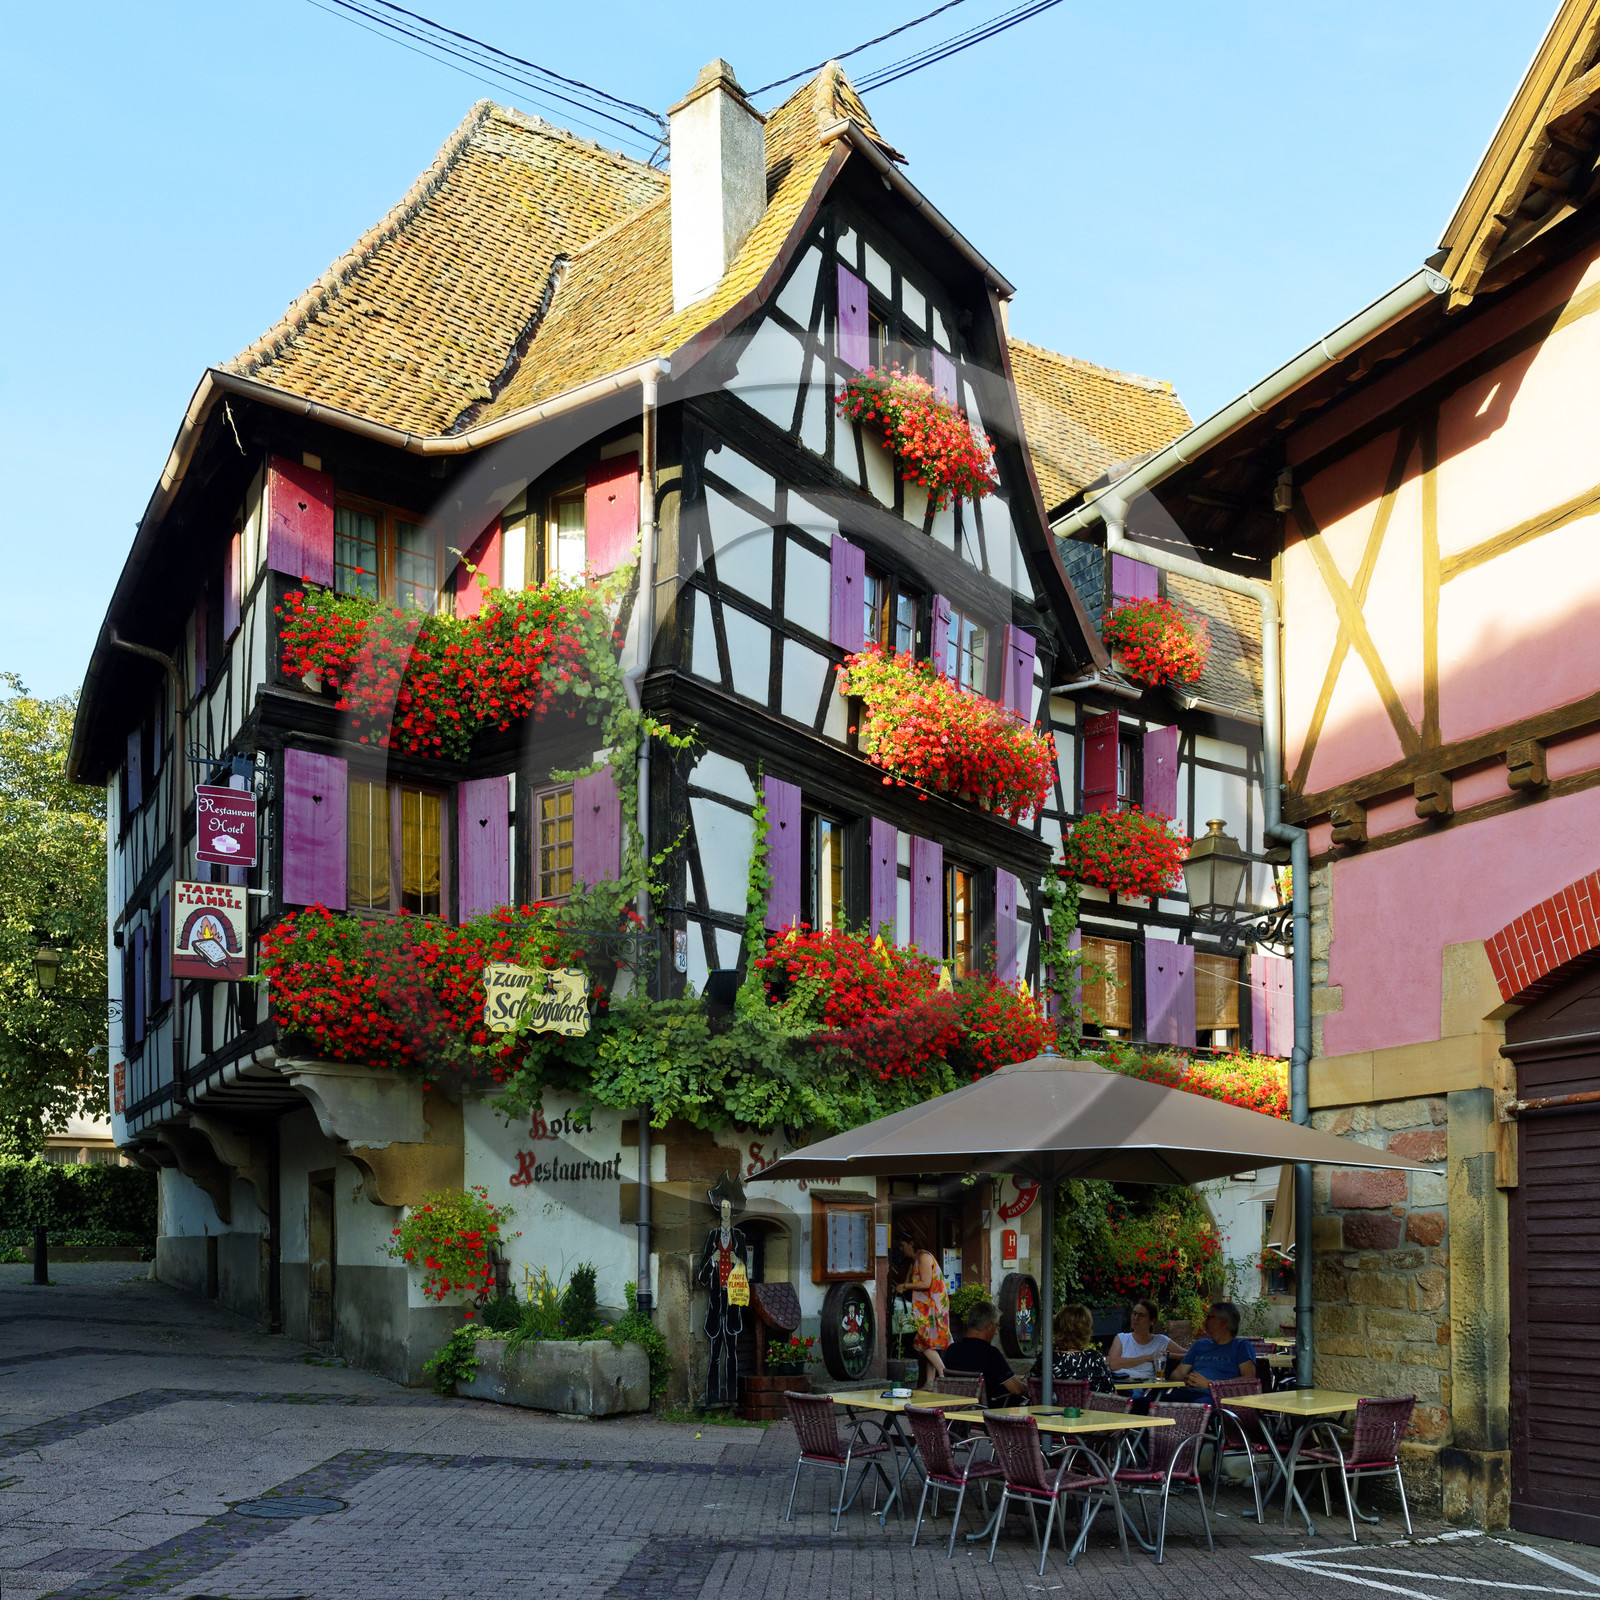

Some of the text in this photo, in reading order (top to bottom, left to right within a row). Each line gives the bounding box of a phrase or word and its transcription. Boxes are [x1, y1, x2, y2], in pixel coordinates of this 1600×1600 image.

[198, 798, 255, 817] Restaurant
[208, 818, 244, 834] Hotel
[182, 883, 233, 898] TARTE
[510, 1149, 622, 1187] Restaurant
[1009, 1235, 1016, 1246] H
